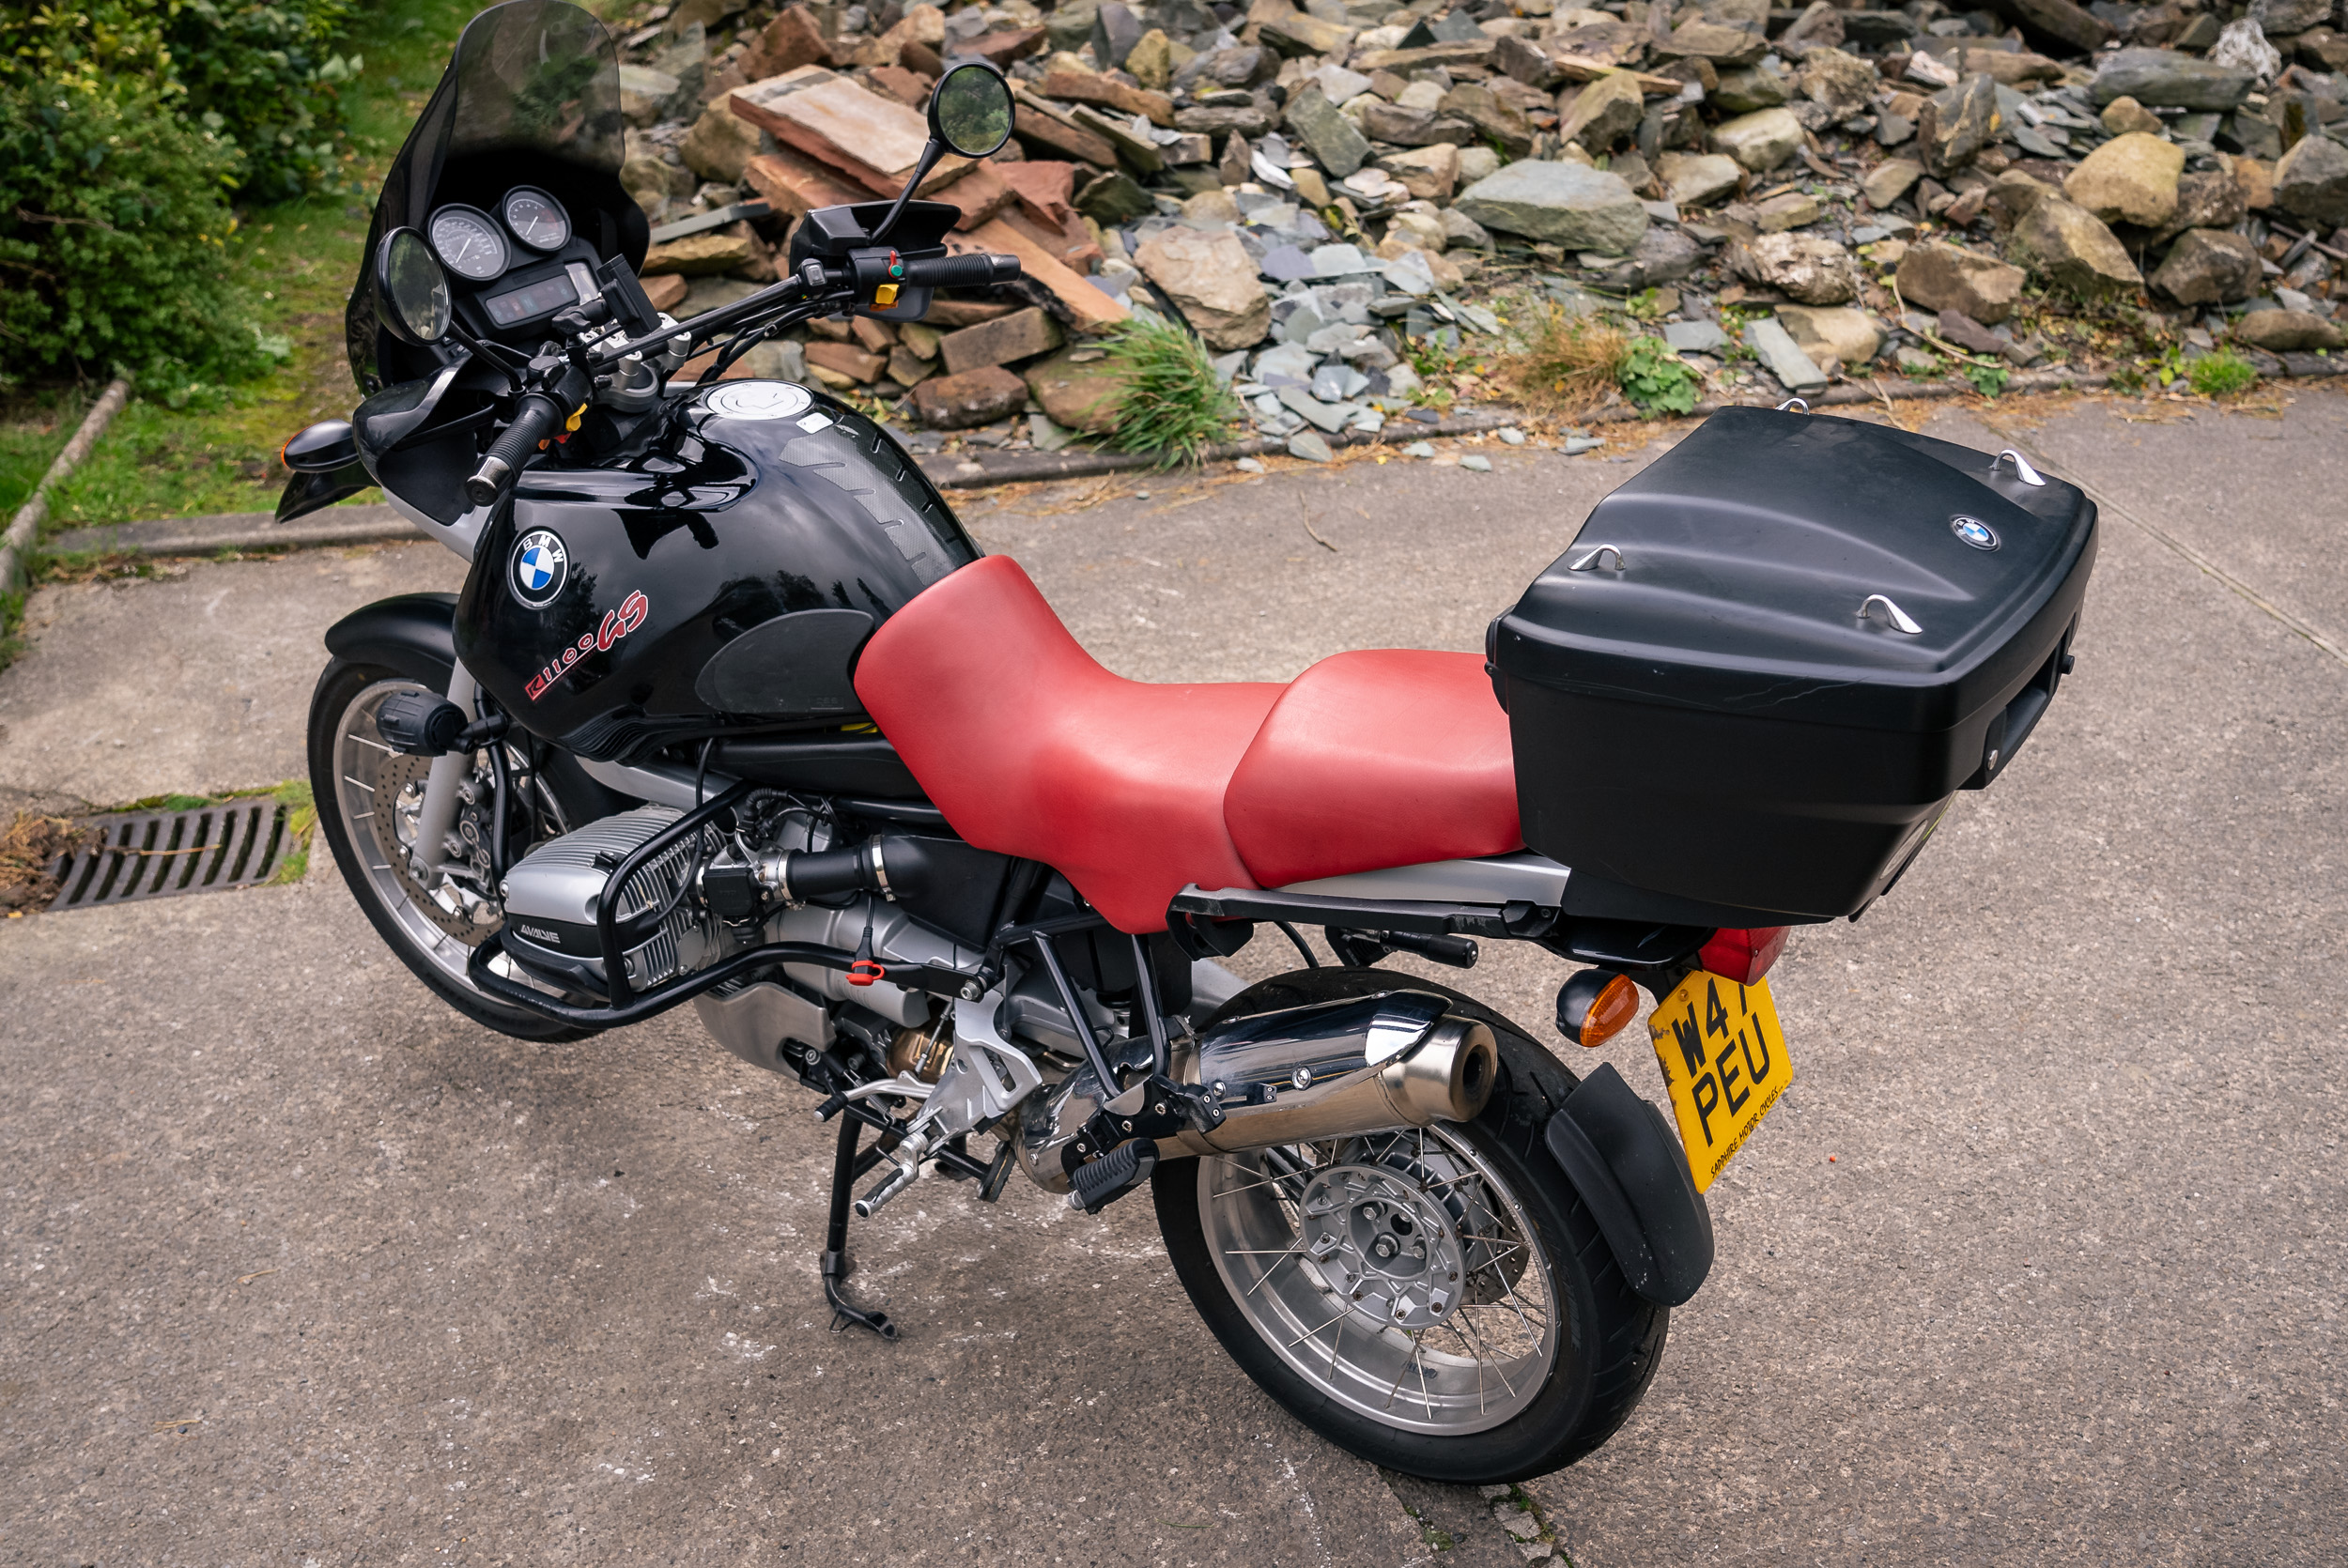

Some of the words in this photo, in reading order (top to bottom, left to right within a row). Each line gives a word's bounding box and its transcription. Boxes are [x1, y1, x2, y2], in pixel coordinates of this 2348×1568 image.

[522, 534, 564, 564] BMW
[1691, 1011, 1770, 1148] PEU
[1710, 1137, 1739, 1179] SAPPHIRE
[1738, 1113, 1759, 1143] MOTOR
[1759, 1085, 1779, 1116] CYCLES
